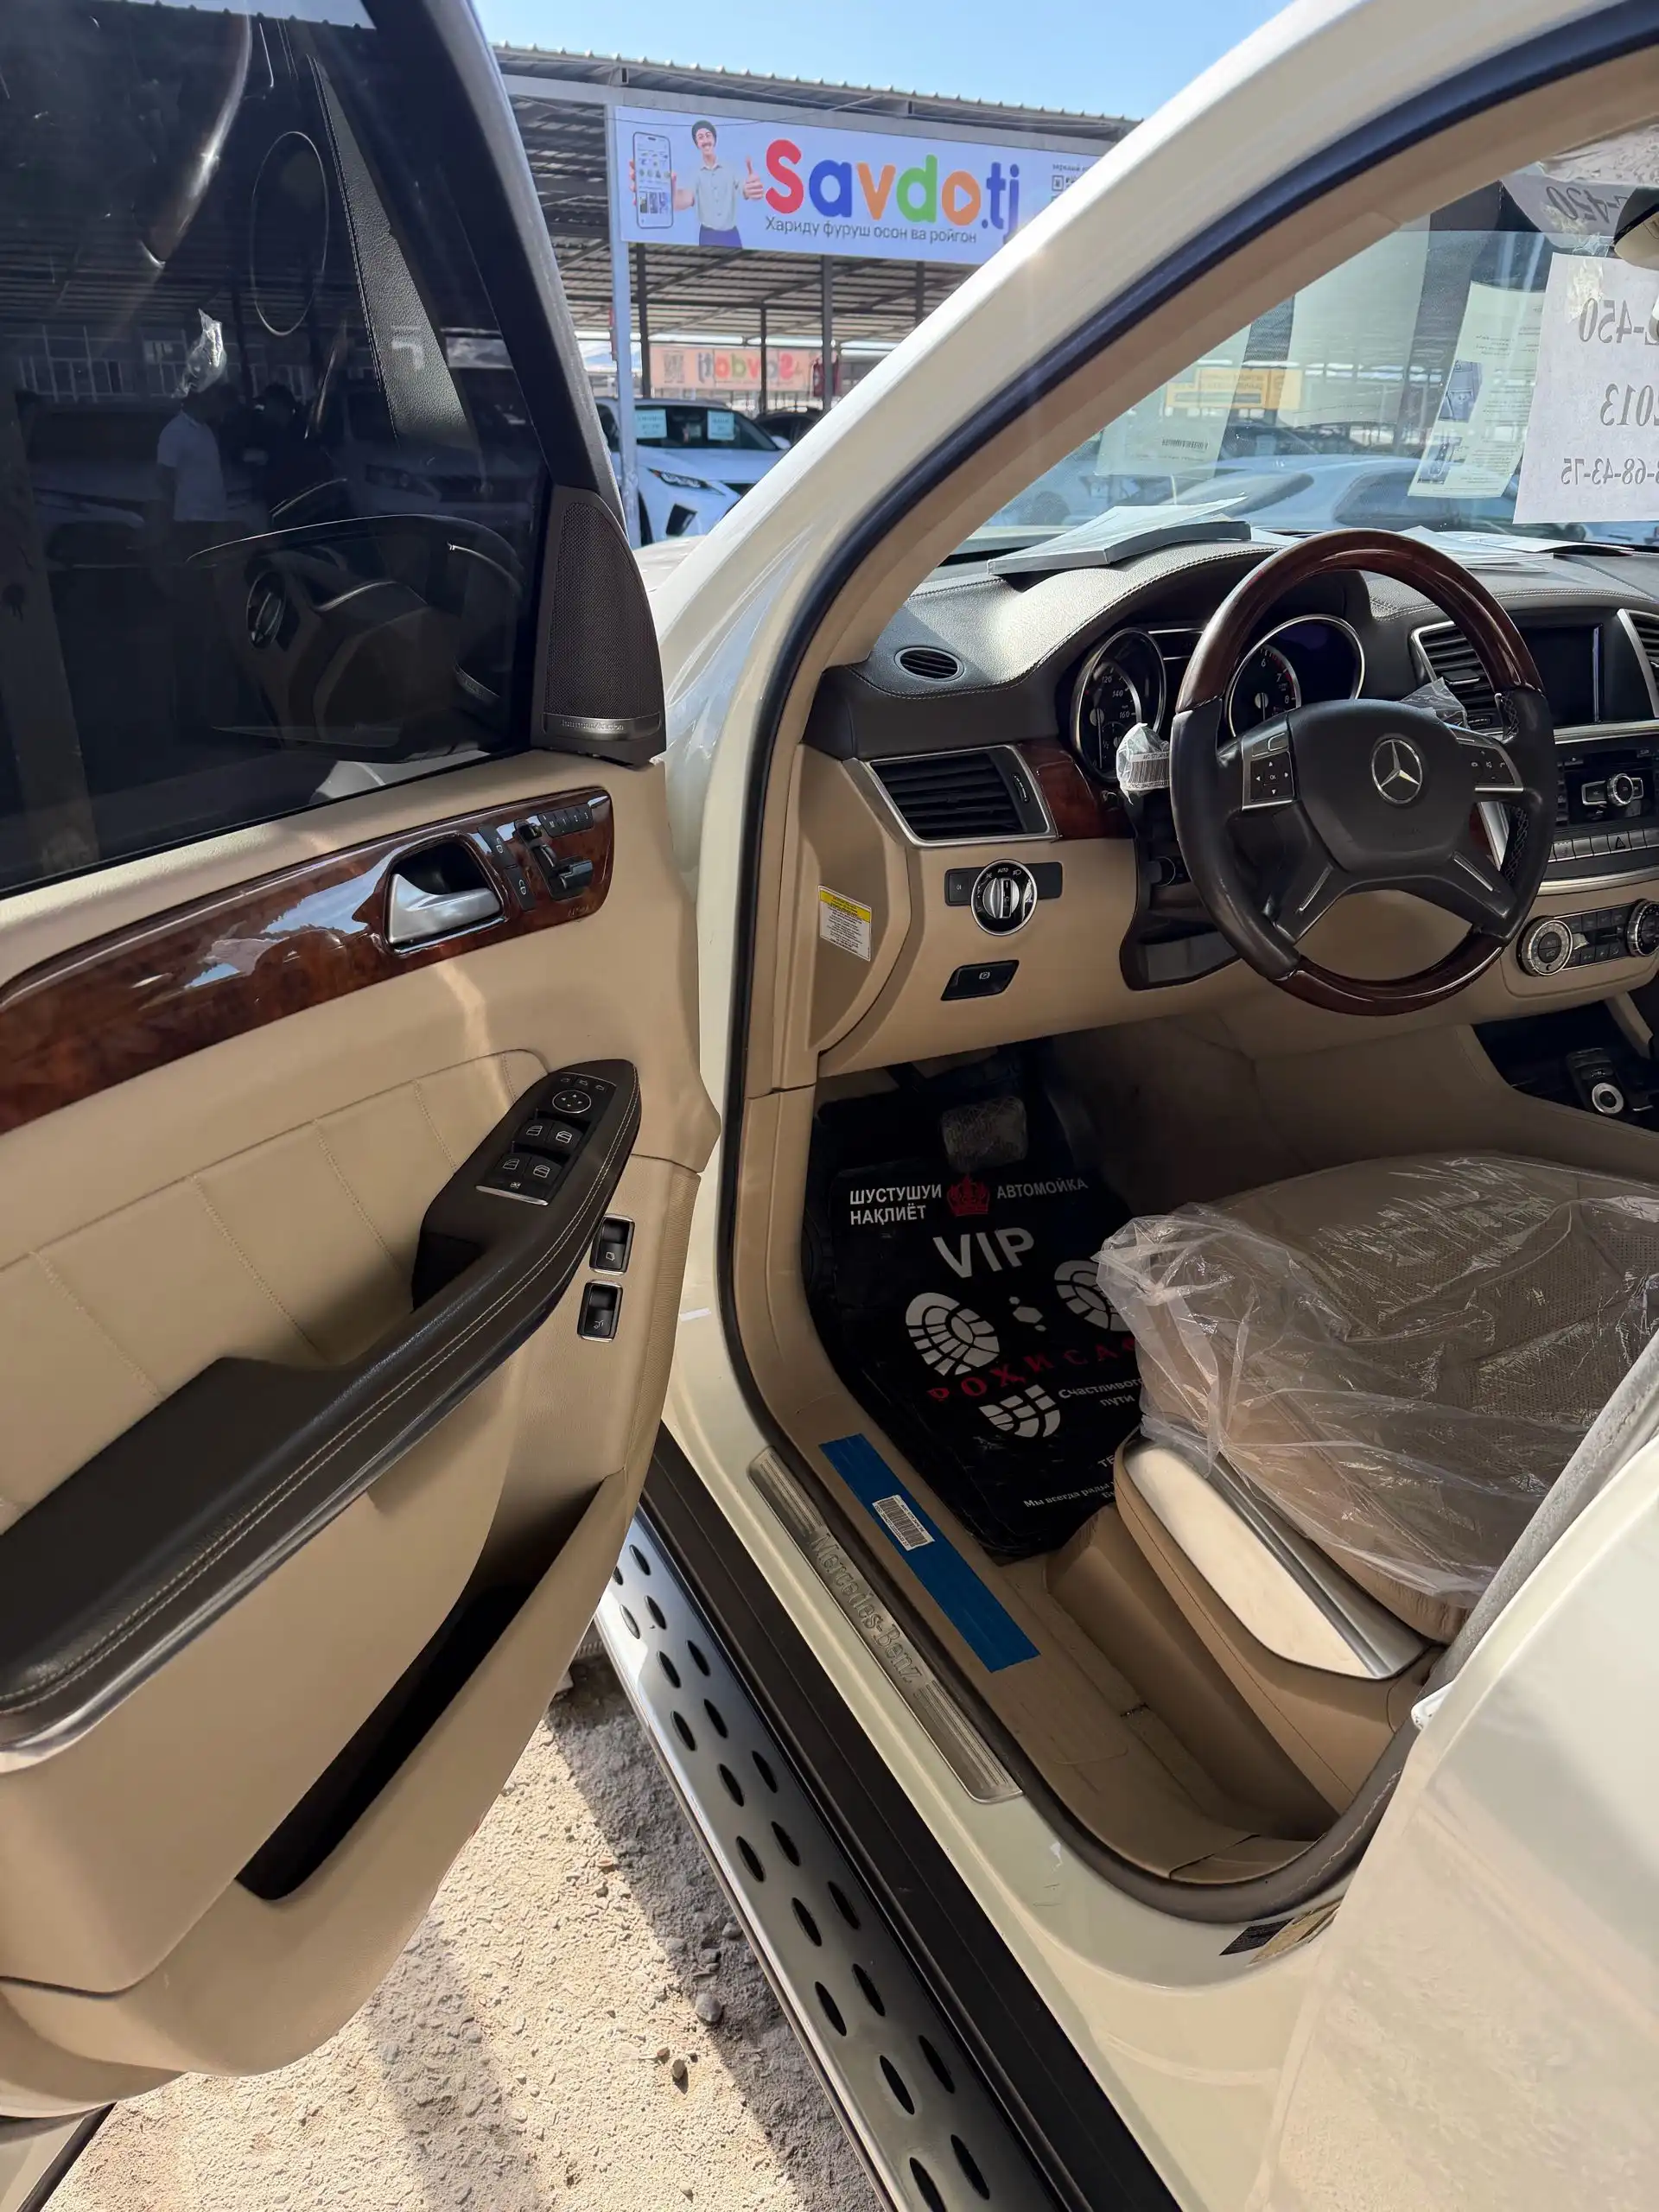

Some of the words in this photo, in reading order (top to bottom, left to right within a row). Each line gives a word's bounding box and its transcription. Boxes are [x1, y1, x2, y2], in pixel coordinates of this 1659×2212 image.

[765, 138, 1020, 245] Savdo.tj
[765, 216, 819, 236] Хариду
[823, 220, 871, 238] фуруш
[874, 226, 908, 240] осон
[911, 228, 926, 241] ва
[930, 228, 977, 245] ройгон
[996, 1177, 1089, 1199] АВТОМОЙКА
[932, 1227, 1035, 1279] VIP
[1099, 1393, 1136, 1408] пути
[809, 1532, 922, 1684] Mercedes-Benz
